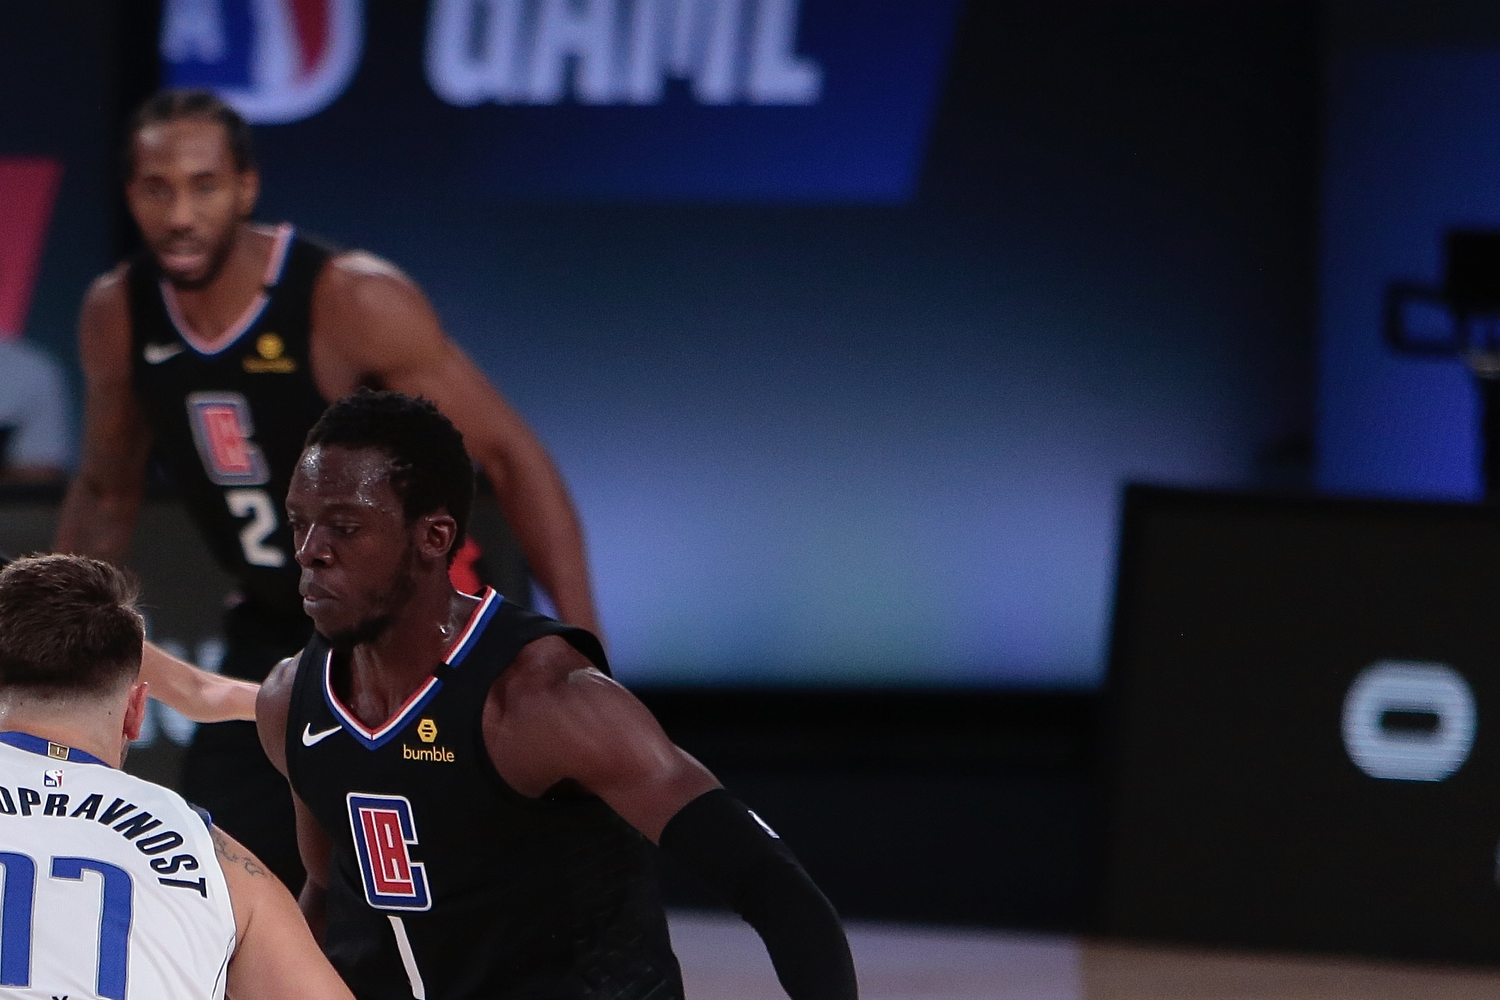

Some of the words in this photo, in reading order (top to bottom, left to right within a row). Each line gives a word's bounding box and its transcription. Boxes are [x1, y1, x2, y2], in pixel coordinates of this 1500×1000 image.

[225, 488, 287, 568] 2
[403, 744, 455, 762] bumble
[387, 915, 426, 1000] 1
